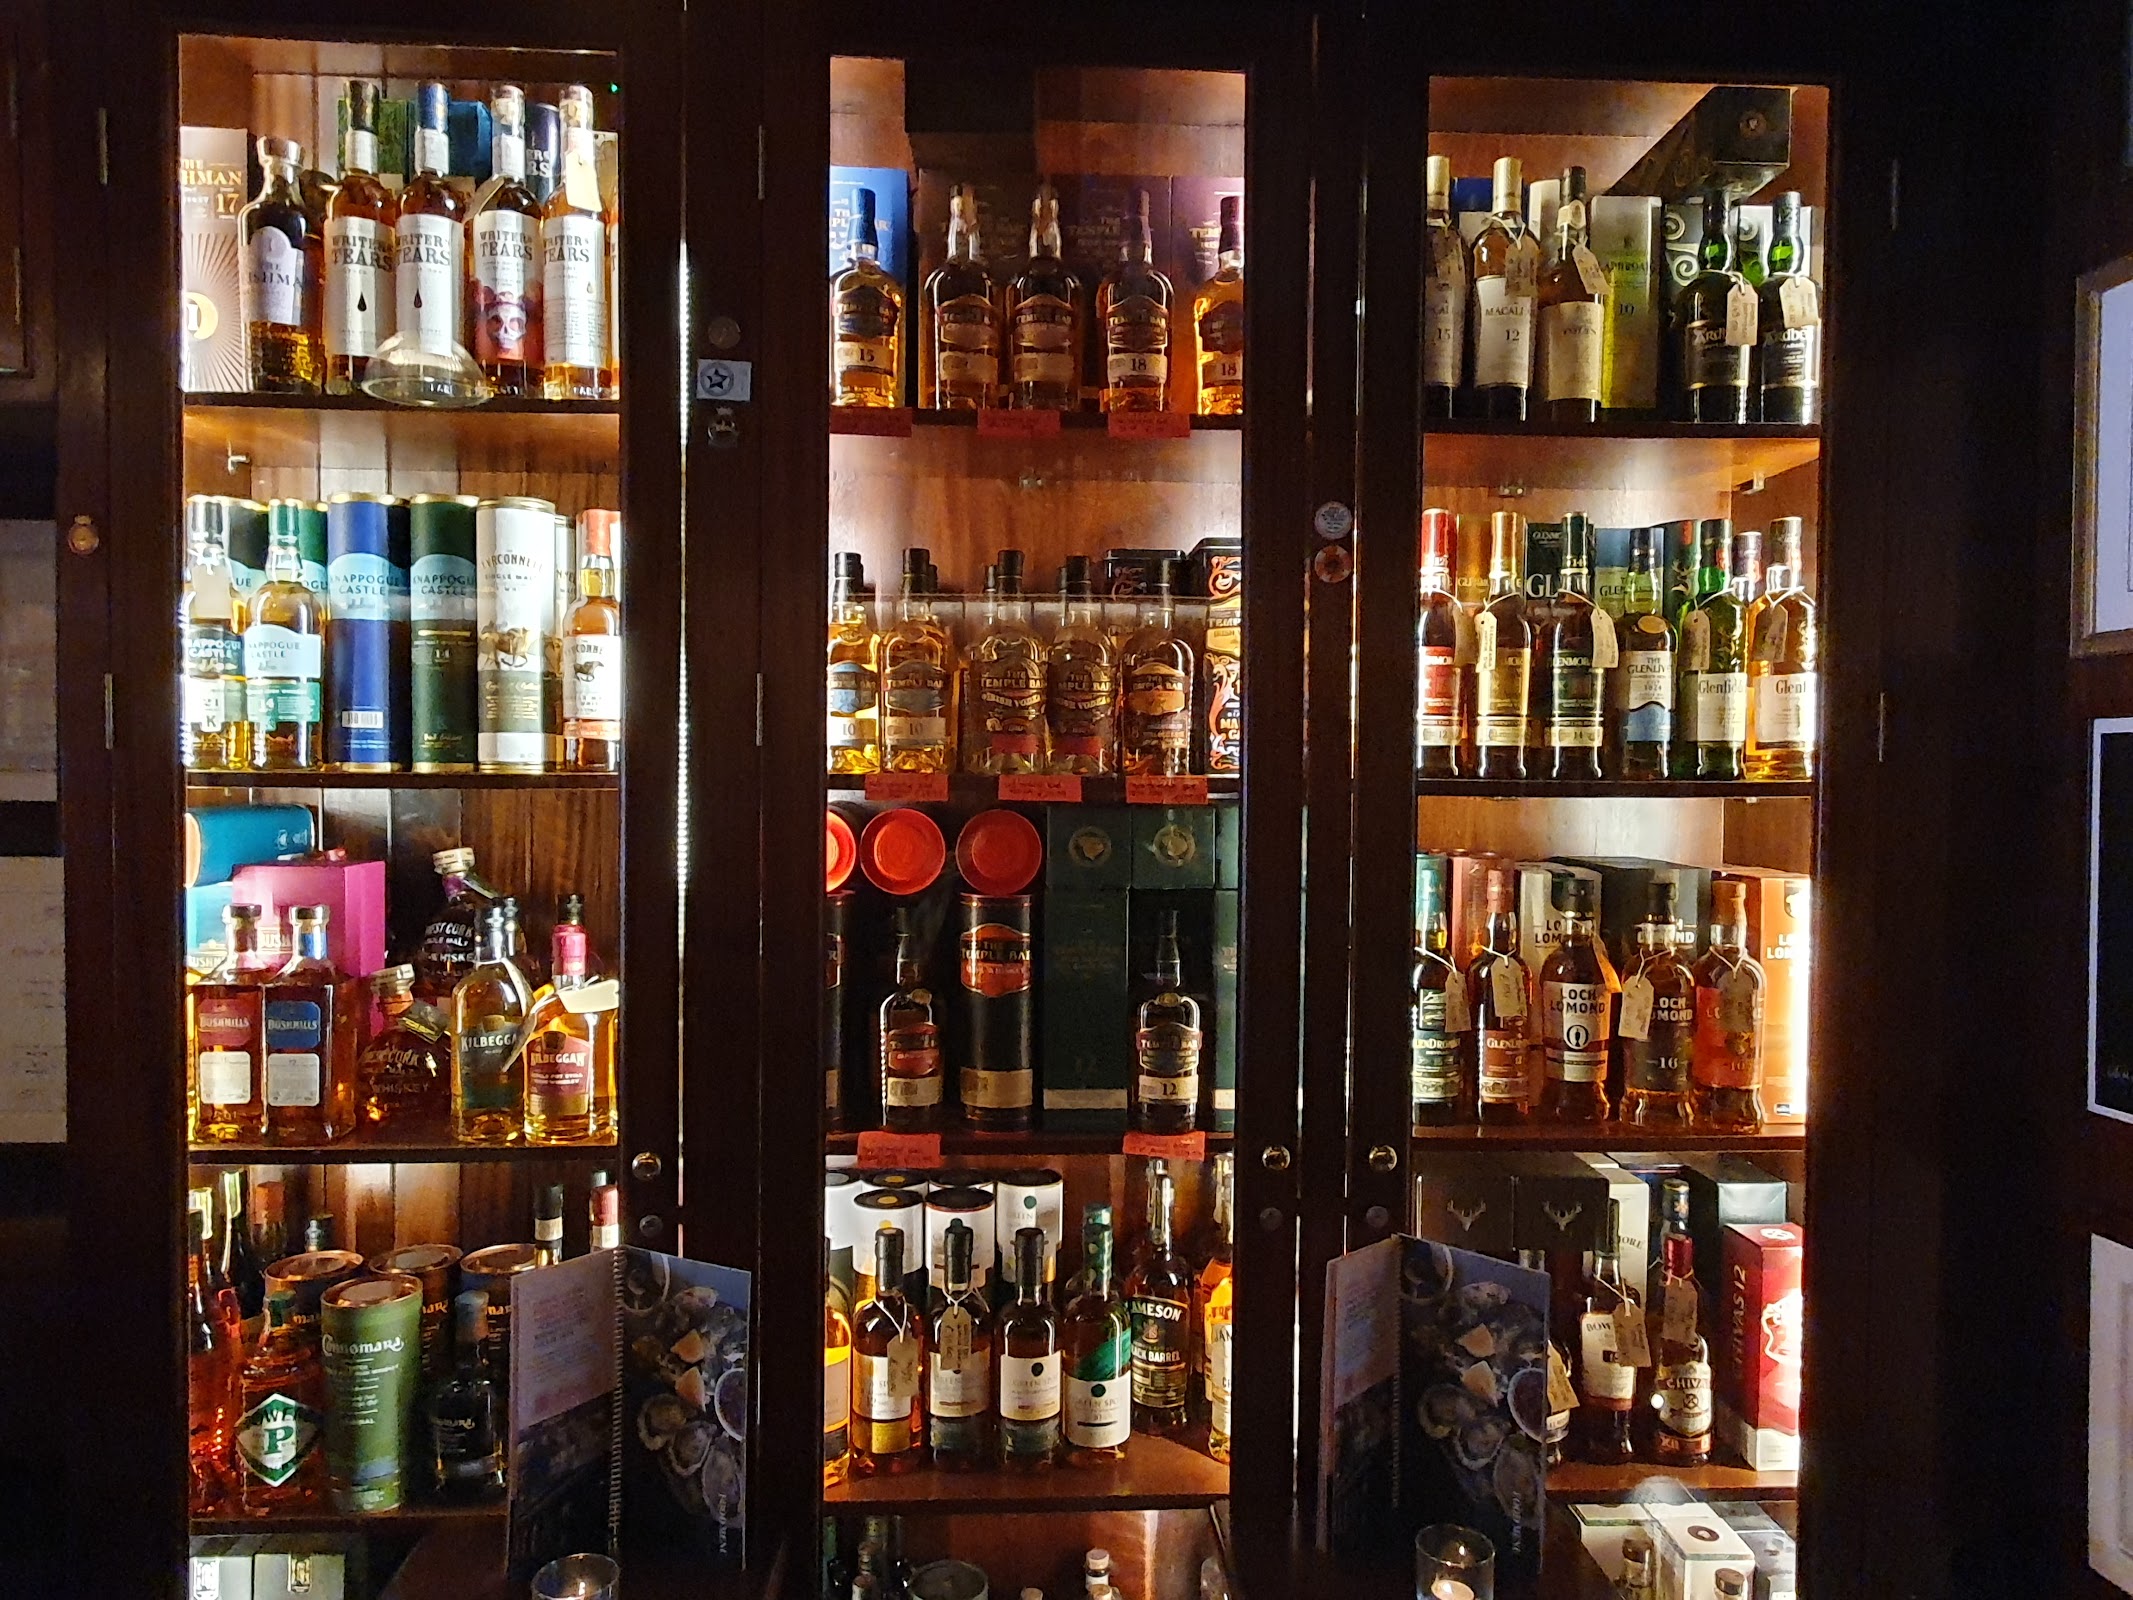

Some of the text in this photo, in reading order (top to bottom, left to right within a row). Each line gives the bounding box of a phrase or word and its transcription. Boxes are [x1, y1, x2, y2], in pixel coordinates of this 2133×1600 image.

[216, 193, 240, 213] 17
[480, 242, 532, 261] TEARS
[332, 248, 394, 273] TEARS
[1437, 328, 1451, 340] 15
[1505, 329, 1520, 341] 12
[1131, 358, 1147, 371] 18
[1221, 363, 1237, 376] 18
[339, 585, 386, 596] CASTLE
[421, 585, 467, 596] CASTLE
[981, 678, 1026, 688] TEMPLE
[842, 723, 856, 735] 10
[908, 723, 923, 735] 10
[1535, 933, 1562, 944] LOM
[1560, 988, 1599, 1001] LOCH
[1550, 1002, 1606, 1014] LOMOND
[1659, 996, 1687, 1009] OCH
[200, 1016, 249, 1028] BUSHMILLS
[268, 1020, 318, 1030] BUSHMILLS
[460, 1034, 518, 1053] KILBEGGA
[531, 1052, 586, 1067] KILBEGGAN
[1160, 1082, 1178, 1096] 12
[1148, 1351, 1181, 1362] BARREL
